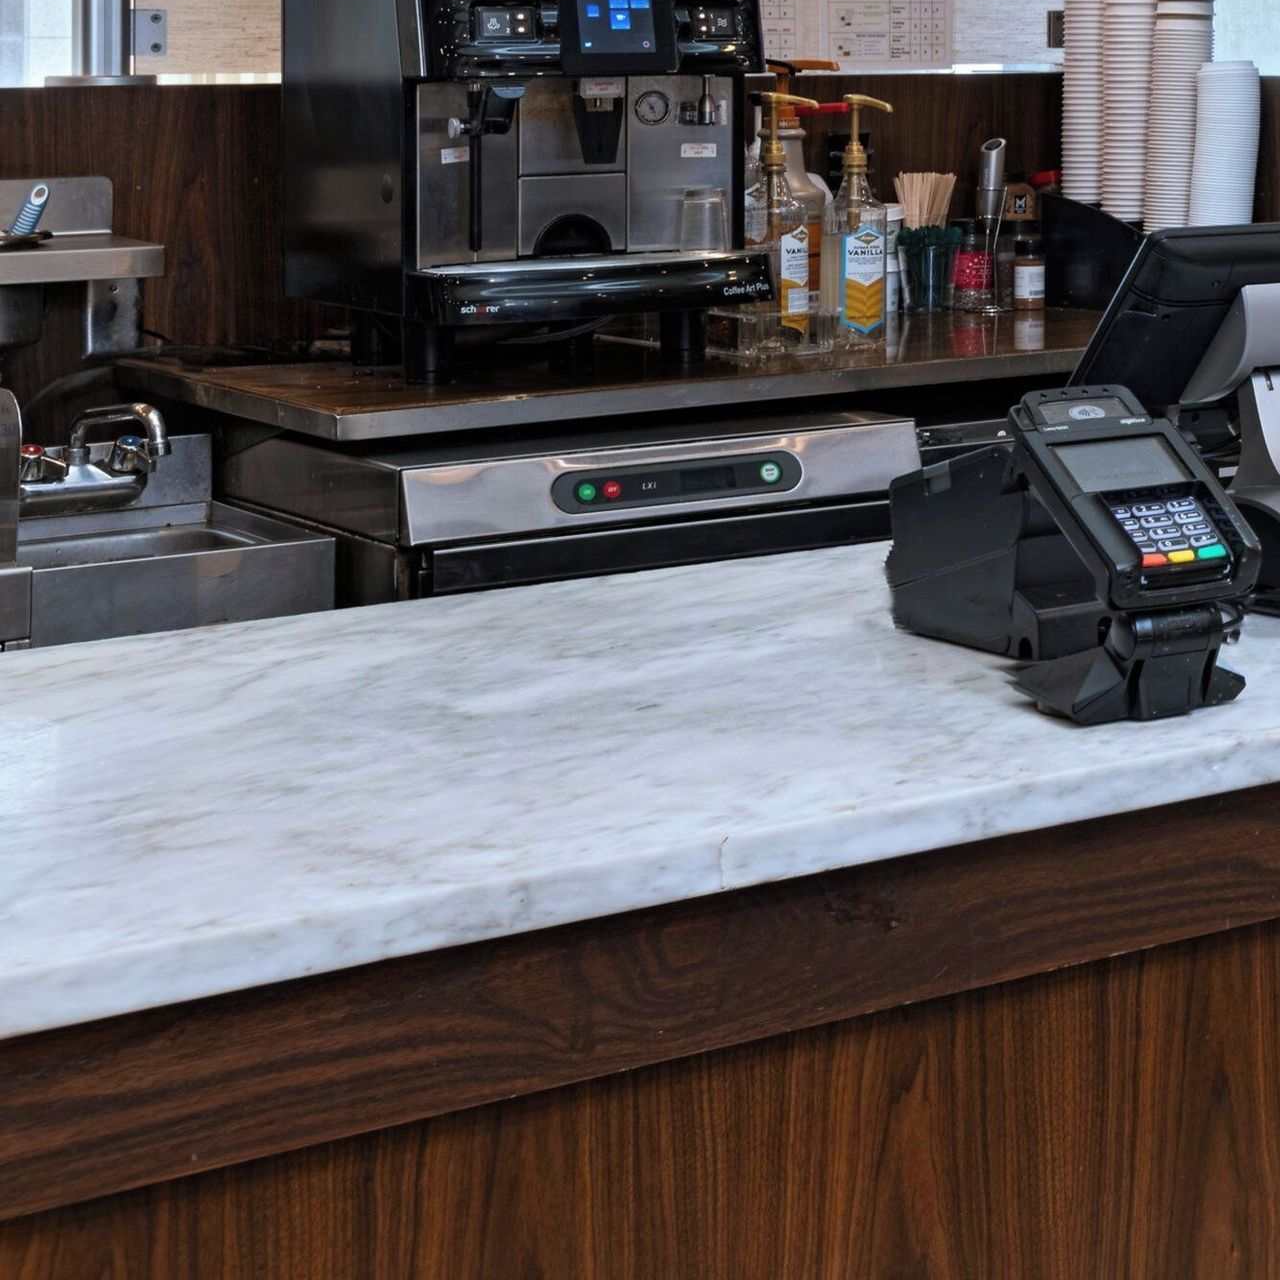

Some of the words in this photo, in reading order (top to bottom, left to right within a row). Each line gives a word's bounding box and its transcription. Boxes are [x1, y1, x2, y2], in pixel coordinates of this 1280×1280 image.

[723, 285, 745, 297] Coffee
[746, 284, 757, 294] Art
[757, 282, 769, 292] Plus
